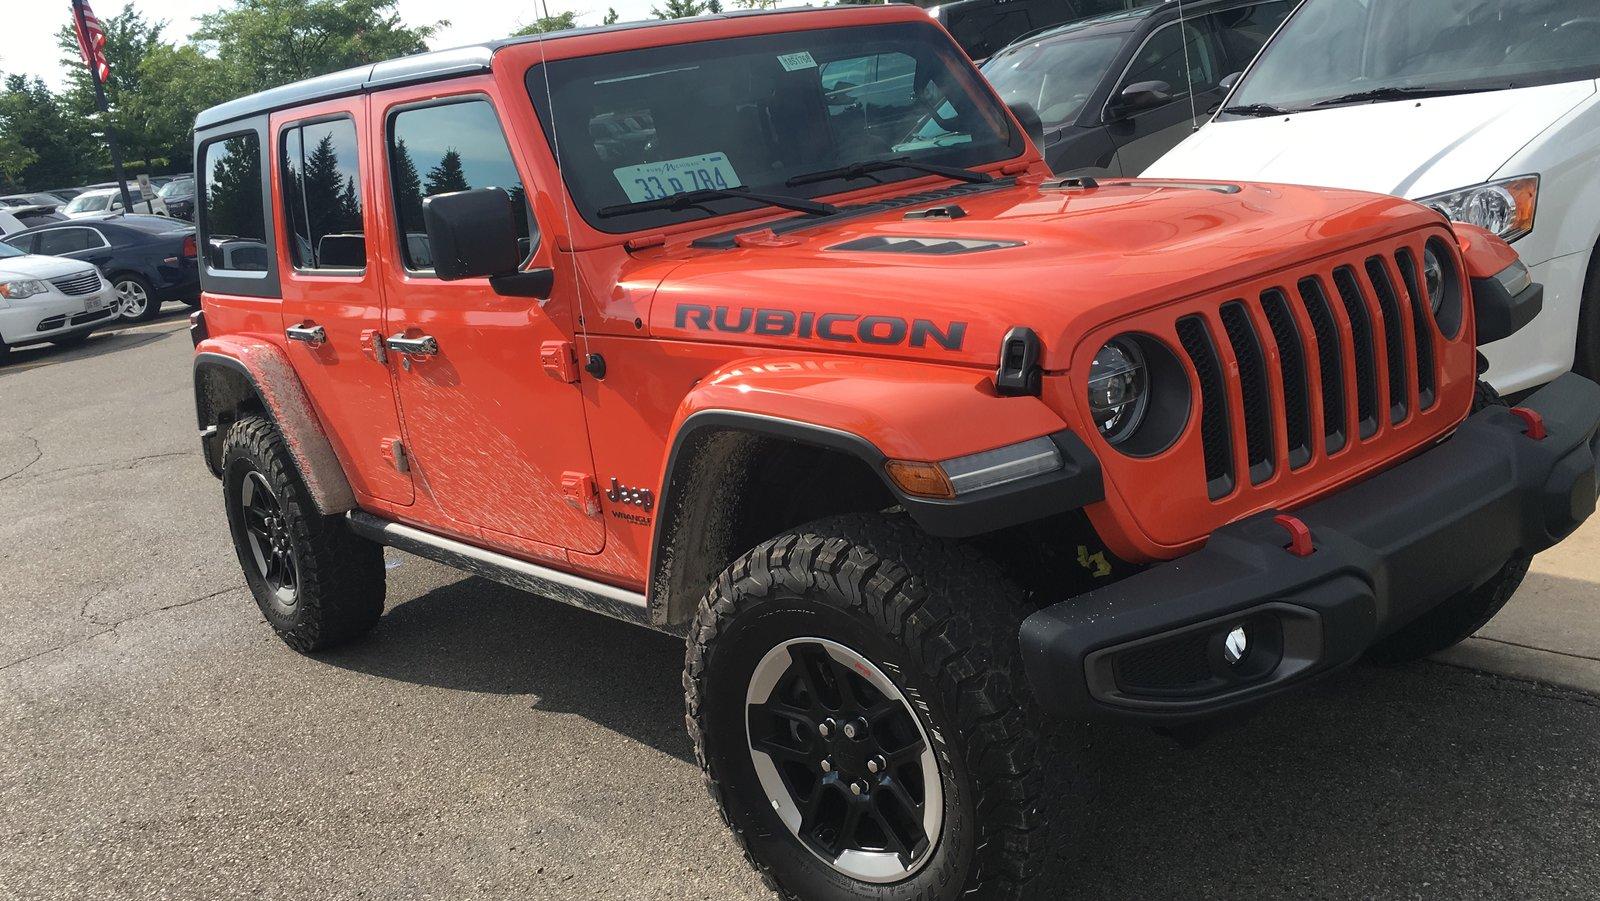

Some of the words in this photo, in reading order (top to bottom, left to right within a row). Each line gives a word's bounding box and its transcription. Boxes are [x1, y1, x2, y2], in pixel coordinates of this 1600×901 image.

[674, 303, 968, 352] RUBICON
[606, 476, 655, 513] Jeep
[612, 510, 652, 523] WRANGLE
